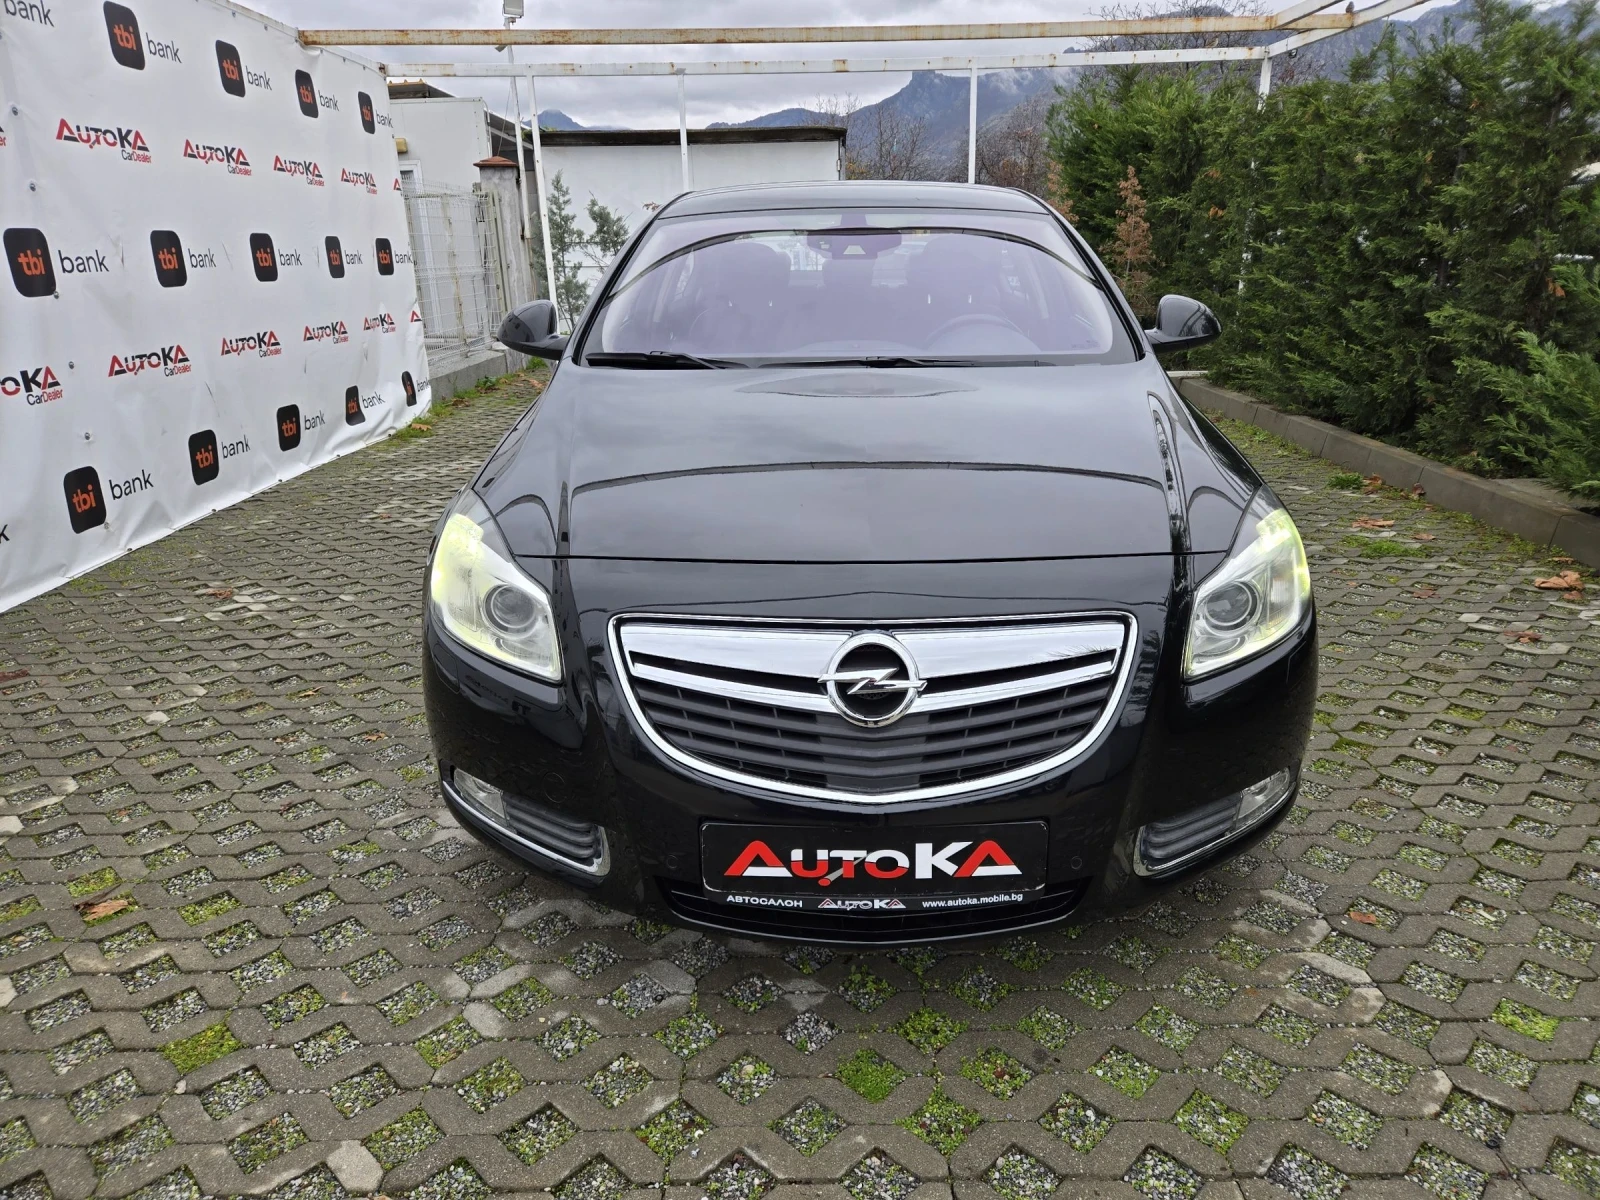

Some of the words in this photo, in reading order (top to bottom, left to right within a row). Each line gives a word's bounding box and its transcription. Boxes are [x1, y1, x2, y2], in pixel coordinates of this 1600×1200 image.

[5, 0, 54, 27] bank
[114, 24, 137, 50] tbi
[146, 33, 182, 63] bank
[223, 58, 240, 81] tbi
[246, 66, 272, 90] bank
[300, 85, 313, 104] tbi
[318, 90, 339, 111] bank
[376, 109, 393, 128] bank
[121, 150, 152, 164] CarDealer
[18, 249, 46, 276] tbi
[58, 250, 109, 273] bank
[158, 247, 178, 270] tbi
[188, 248, 216, 268] bank
[256, 248, 272, 267] tbi
[278, 249, 302, 266] bank
[344, 250, 363, 264] bank
[394, 250, 413, 264] bank
[164, 363, 192, 377] CarDealer
[26, 389, 63, 406] CarDealer
[361, 392, 386, 408] bank
[282, 417, 297, 437] tbi
[304, 410, 326, 430] bank
[196, 444, 214, 469] tbi
[222, 434, 250, 459] bank
[72, 484, 96, 513] tbi
[109, 469, 154, 500] bank
[724, 840, 1022, 887] AUTOKA
[727, 895, 803, 908] АВТОСАЛОН
[922, 893, 1023, 908] www.autoka.mobile.bg
